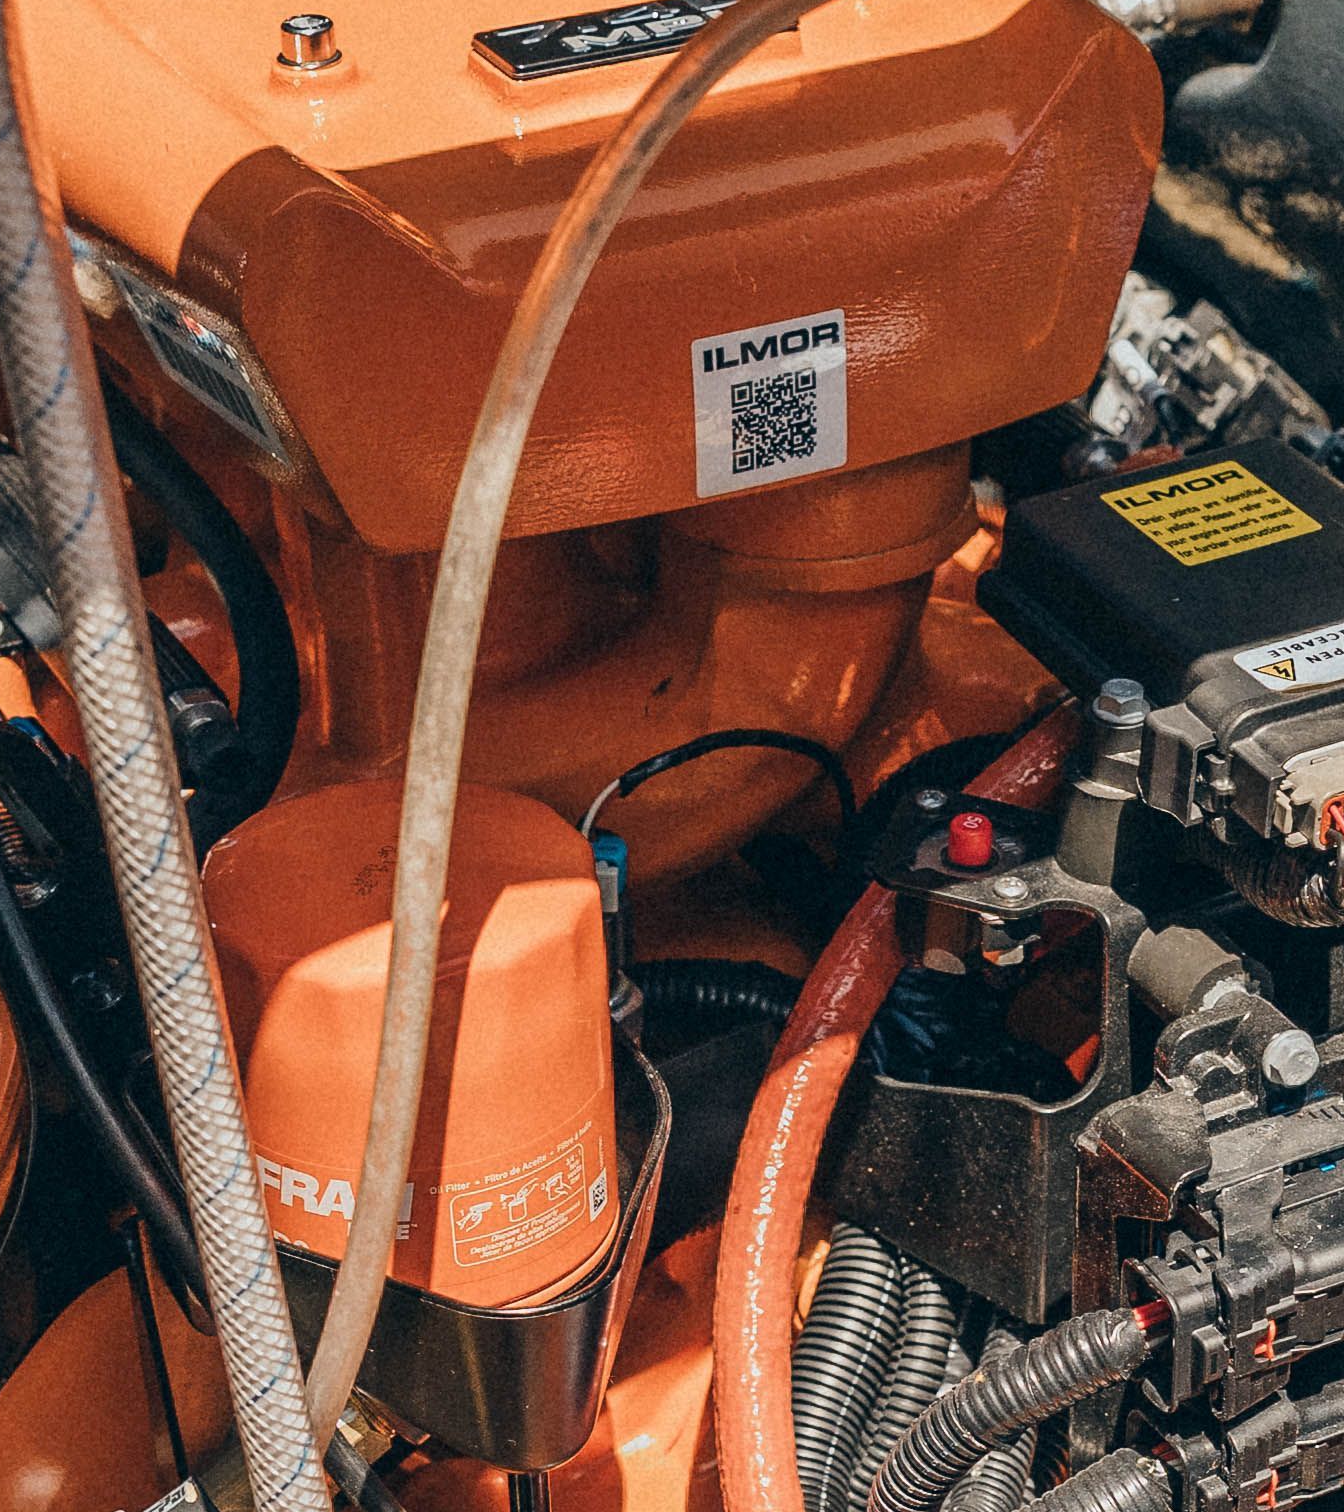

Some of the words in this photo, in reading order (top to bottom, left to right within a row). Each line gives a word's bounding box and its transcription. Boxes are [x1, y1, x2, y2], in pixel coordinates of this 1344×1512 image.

[703, 321, 840, 373] ILMOR
[1113, 469, 1244, 510] ILMOR
[1169, 506, 1201, 520] points
[1203, 500, 1221, 509] are
[1223, 487, 1269, 504] identified
[1166, 537, 1188, 549] your
[1189, 527, 1221, 542] engine
[1221, 517, 1259, 533] owner's
[1260, 506, 1296, 522] manual
[1202, 510, 1236, 523] Please
[1239, 501, 1262, 513] refer
[1266, 497, 1281, 506] to
[1177, 548, 1195, 559] for
[1194, 539, 1231, 555] further
[255, 1154, 414, 1222] FRA
[445, 1181, 471, 1193] Filter
[484, 1169, 508, 1184] Filtro
[509, 1166, 521, 1176] de
[522, 1154, 547, 1172] Aceite
